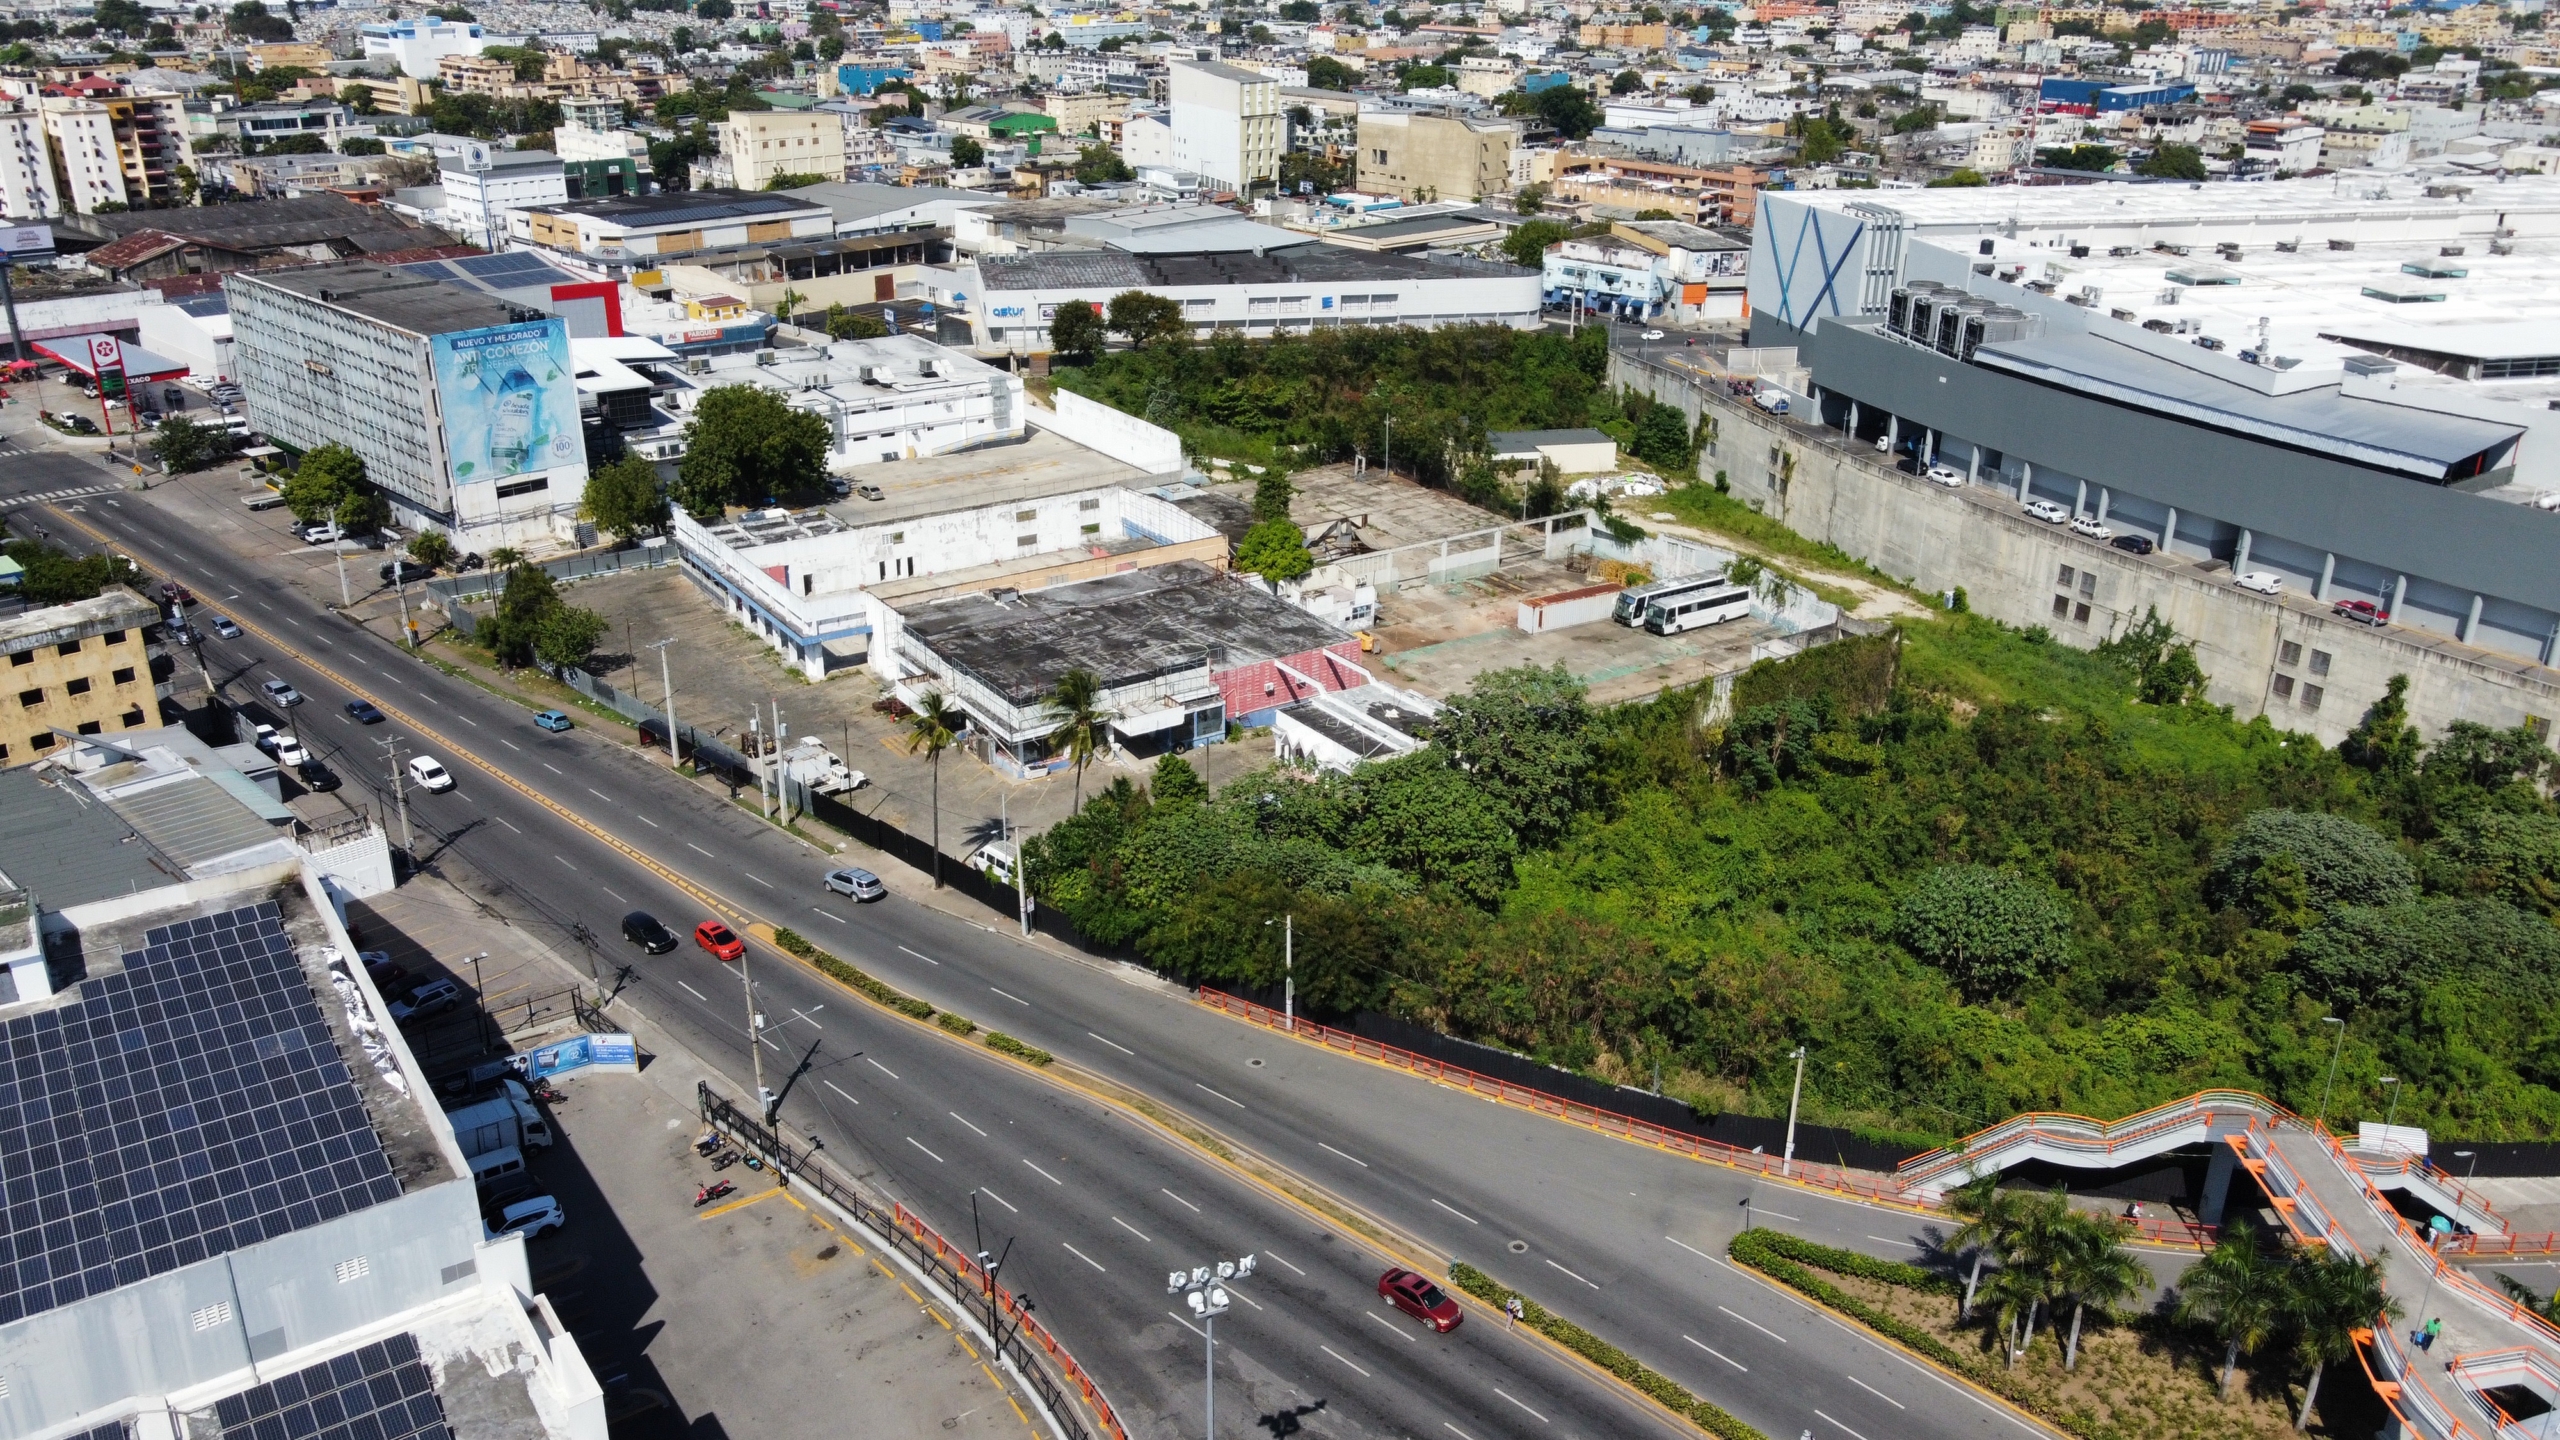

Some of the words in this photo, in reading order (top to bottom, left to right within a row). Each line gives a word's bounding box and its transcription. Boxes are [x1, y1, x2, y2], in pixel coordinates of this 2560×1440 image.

[688, 329, 718, 338] PARQUEO
[457, 338, 485, 348] NUEVO
[487, 336, 493, 344] Y
[127, 376, 151, 384] EXACO
[556, 441, 570, 452] 100
